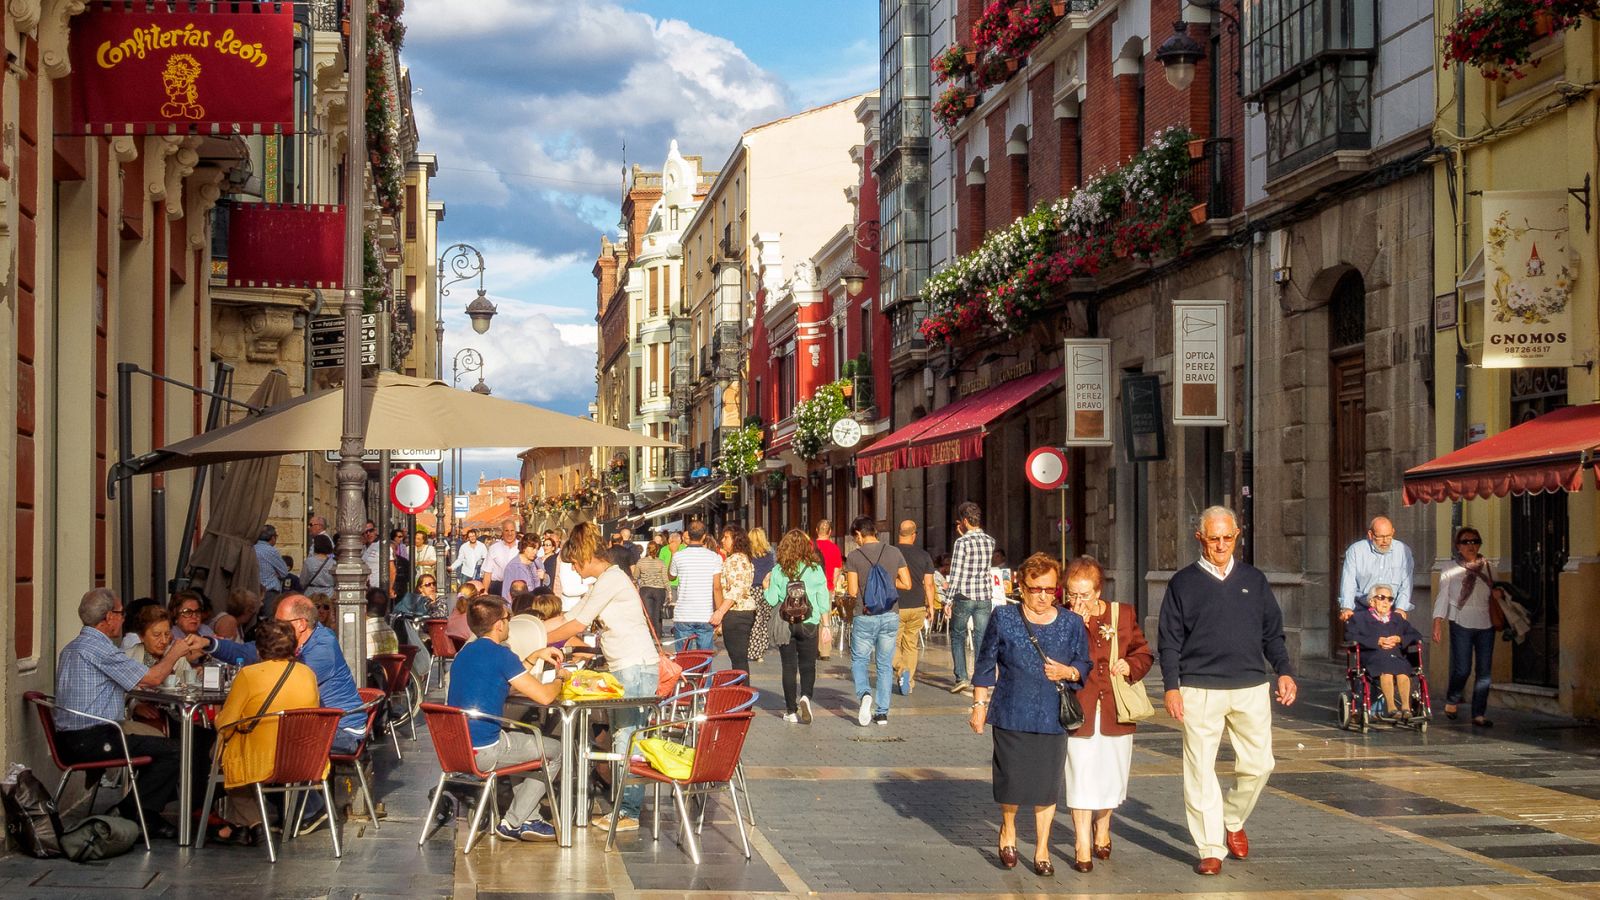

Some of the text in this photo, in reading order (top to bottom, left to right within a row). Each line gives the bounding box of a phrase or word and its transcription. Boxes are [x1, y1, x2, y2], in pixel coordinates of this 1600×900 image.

[96, 23, 268, 69] Confiterías León
[1490, 332, 1567, 345] GNOMOS
[1185, 351, 1216, 360] OPTICA
[1185, 362, 1216, 371] PEREZ
[1185, 373, 1216, 382] BRAVO
[1076, 383, 1101, 391] OPTICA
[1076, 392, 1102, 400] PEREZ
[1076, 401, 1102, 409] BRAVO
